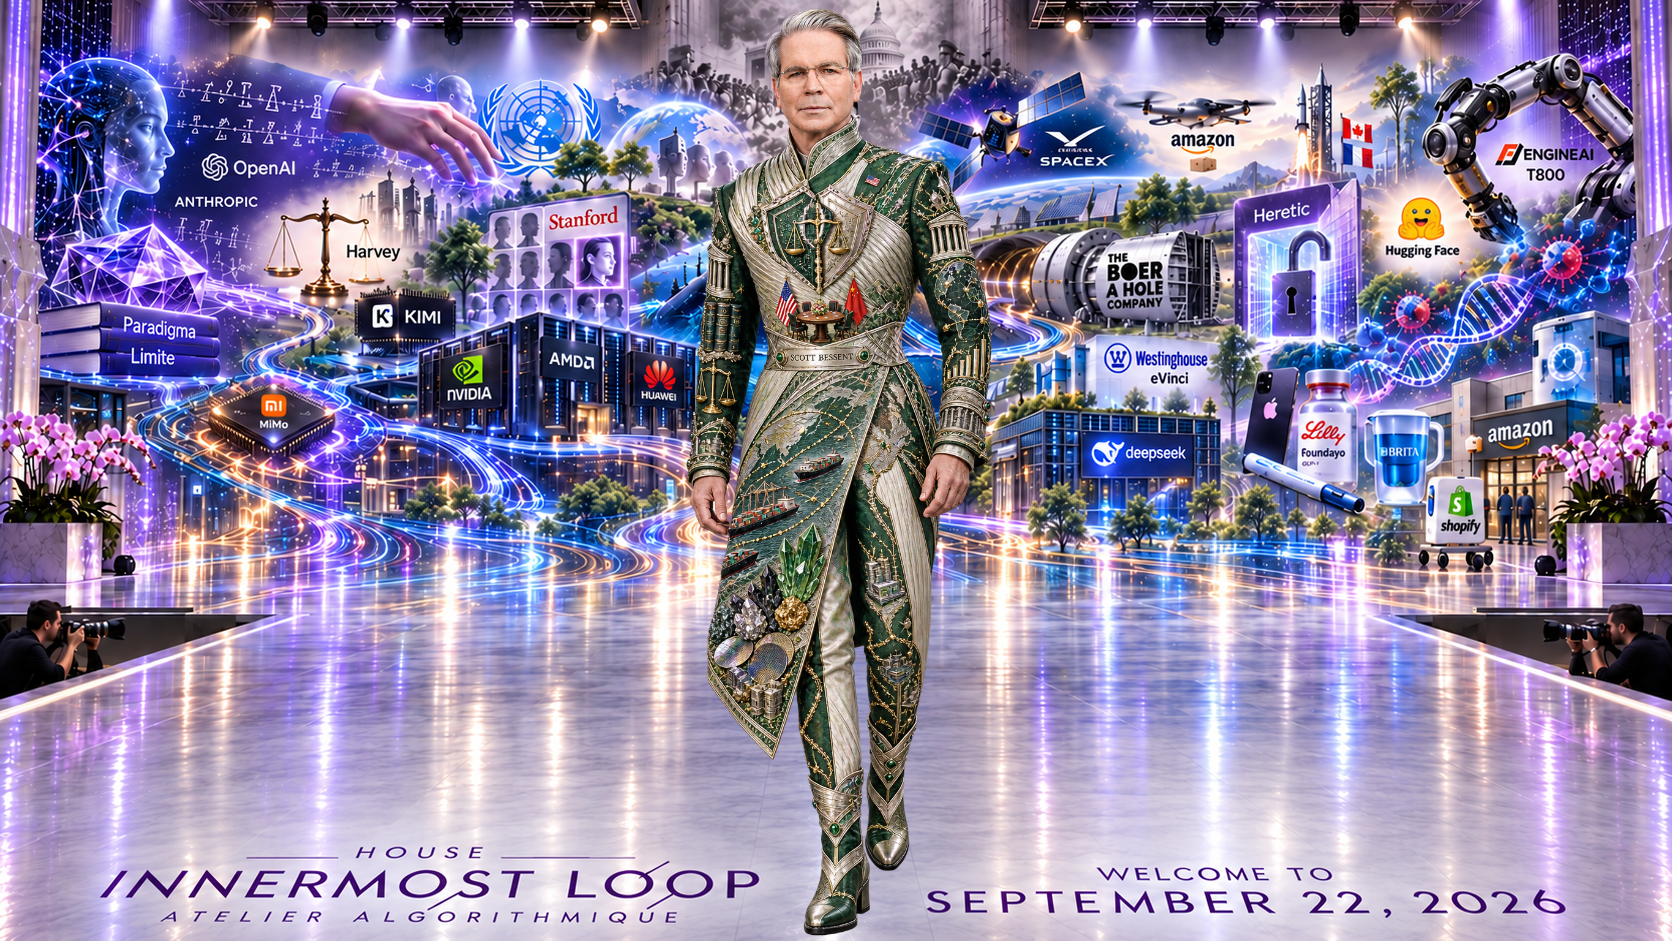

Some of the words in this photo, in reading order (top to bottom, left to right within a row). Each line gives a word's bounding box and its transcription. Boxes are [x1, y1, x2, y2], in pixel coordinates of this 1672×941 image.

[1171, 133, 1235, 148] amazon
[1040, 154, 1115, 167] SPACEX
[1523, 148, 1594, 160] ENGINEAI
[233, 160, 296, 178] OpenAI
[1526, 168, 1565, 181] T800
[174, 196, 258, 208] ANTHROPIC
[549, 205, 618, 230] Stanford
[1253, 202, 1310, 223] Heretic
[346, 244, 401, 262] Harvey
[1108, 253, 1128, 263] THE
[1385, 245, 1432, 258] Hugging
[1434, 245, 1460, 256] Face
[1106, 283, 1118, 298] A
[1123, 281, 1163, 297] HOLE
[1107, 297, 1163, 310] COMPANY
[405, 309, 441, 324] KIMI
[123, 316, 196, 340] Paradigma
[131, 347, 175, 365] Limite
[549, 351, 584, 368] AMD
[790, 354, 816, 362] SCOTT
[818, 353, 853, 362] BESSENT
[1135, 351, 1208, 370] Westinghouse
[1150, 372, 1189, 384] eVinci
[641, 390, 677, 401] HUAWEI
[259, 419, 289, 429] MiMo
[1488, 419, 1553, 443] amazon
[1301, 420, 1346, 446] Lilly
[1125, 446, 1186, 462] deepseek
[1301, 448, 1346, 460] Foundayo
[1389, 447, 1420, 457] BRITA
[1440, 519, 1481, 535] shopify
